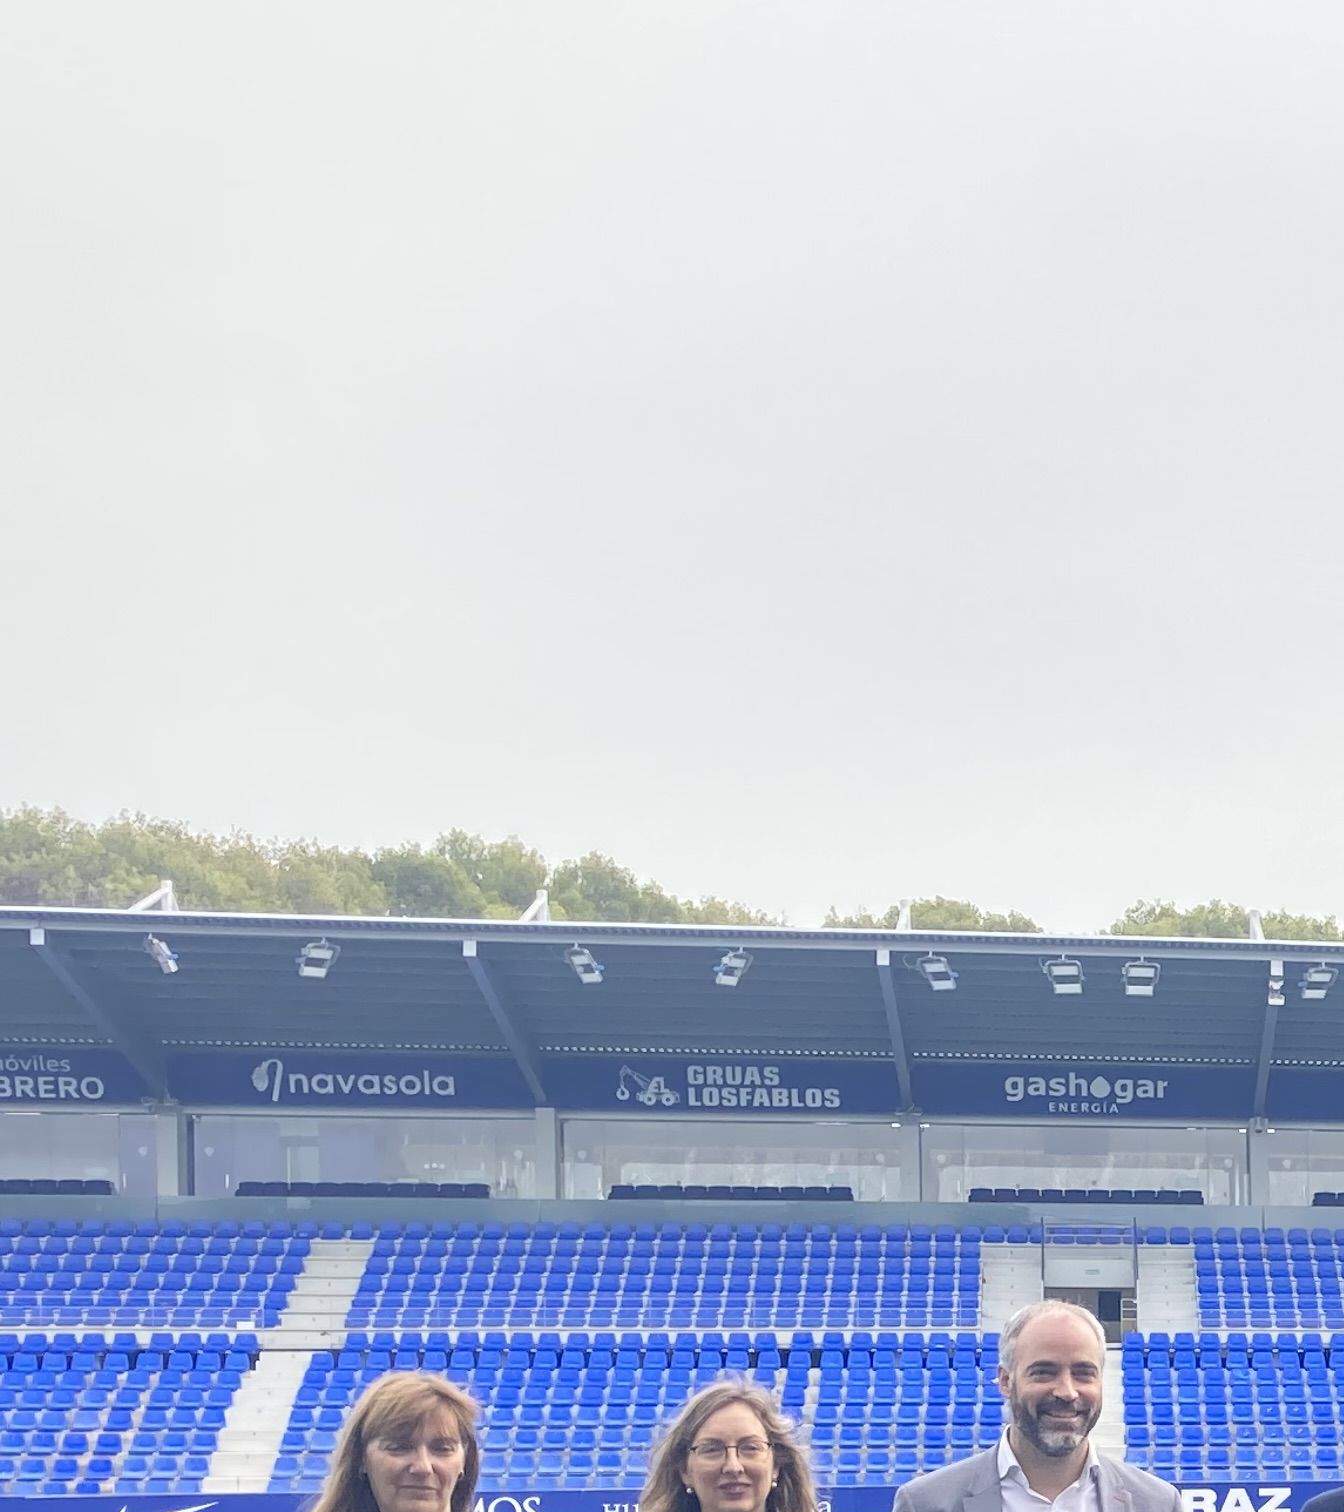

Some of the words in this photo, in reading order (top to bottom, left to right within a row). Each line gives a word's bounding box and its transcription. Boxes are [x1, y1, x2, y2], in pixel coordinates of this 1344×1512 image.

[288, 1069, 455, 1096] navasola
[687, 1065, 779, 1086] GRUAS
[688, 1088, 841, 1107] LOSFABLOS
